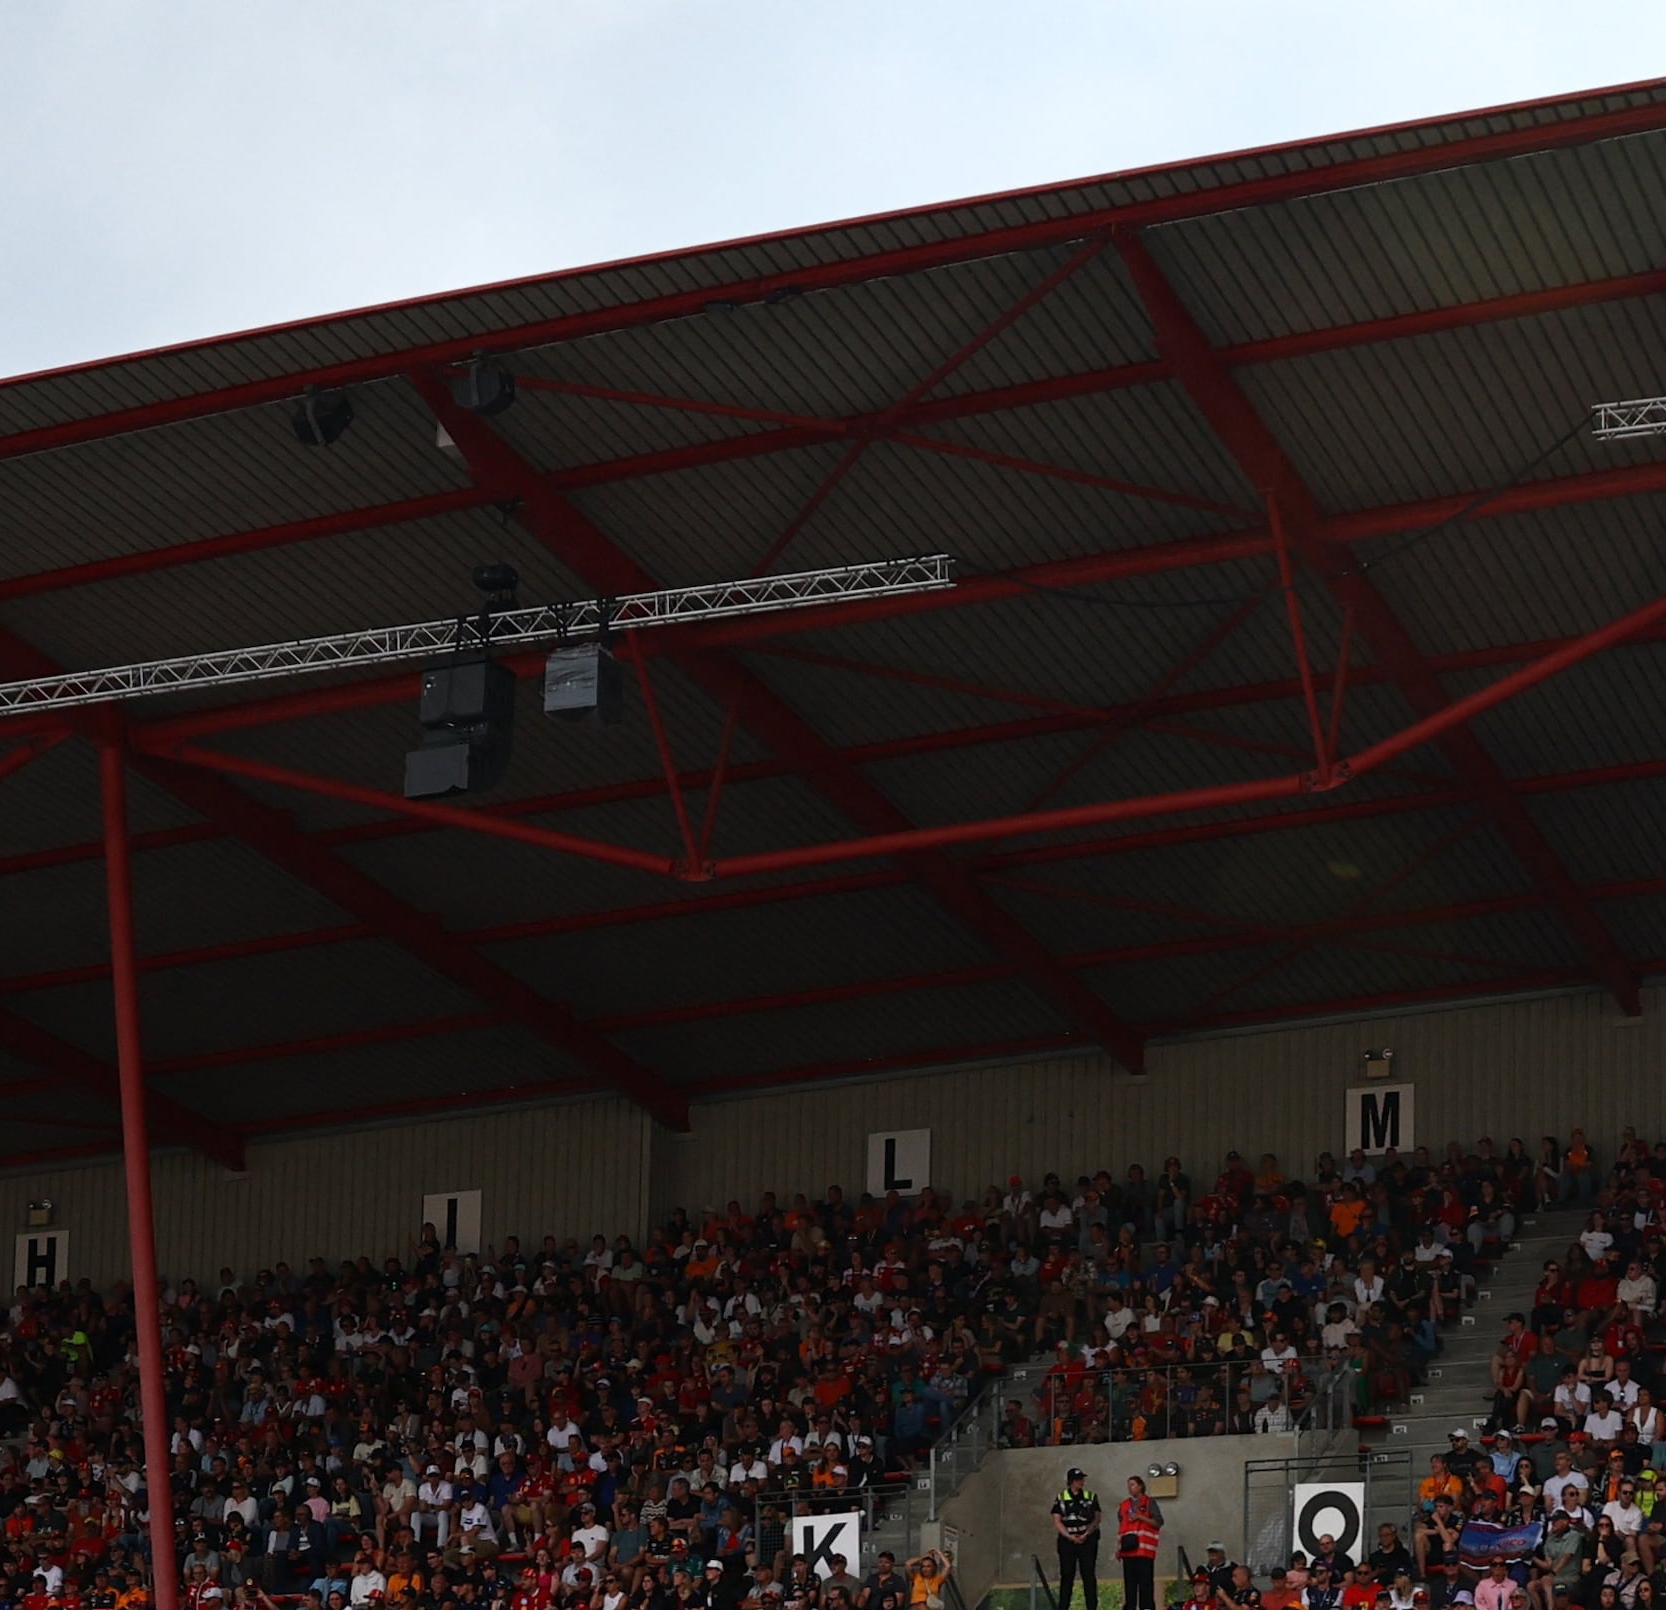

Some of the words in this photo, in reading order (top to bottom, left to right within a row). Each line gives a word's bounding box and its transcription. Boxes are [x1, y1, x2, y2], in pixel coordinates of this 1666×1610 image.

[1360, 1091, 1400, 1149] M
[884, 1138, 913, 1190] L
[27, 1236, 56, 1287] H
[803, 1522, 847, 1577] K
[1298, 1490, 1360, 1557] O
